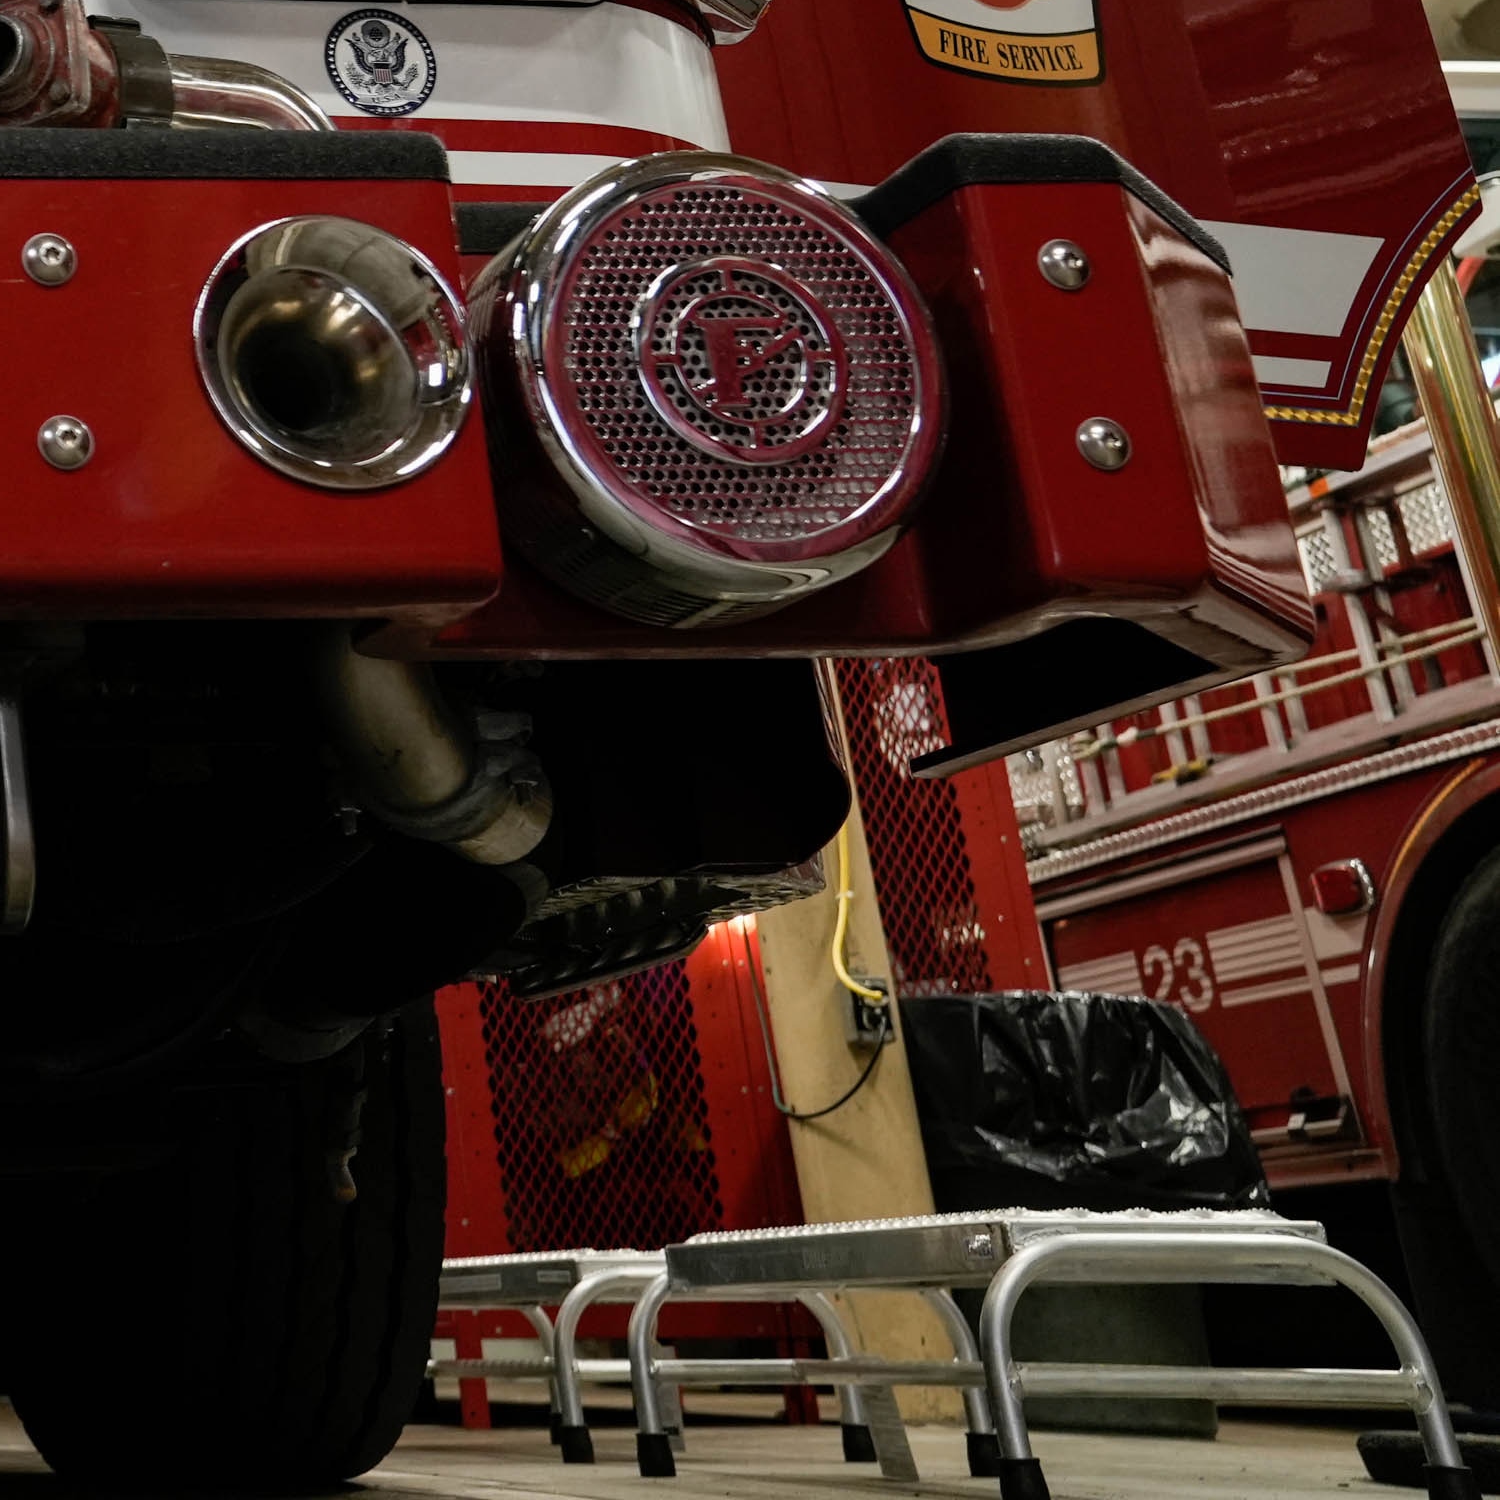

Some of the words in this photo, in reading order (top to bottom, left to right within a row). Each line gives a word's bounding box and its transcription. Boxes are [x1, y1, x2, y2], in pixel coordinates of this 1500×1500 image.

[938, 27, 990, 66] FIRE
[996, 41, 1084, 73] SERVICE
[1142, 936, 1215, 1013] 23
